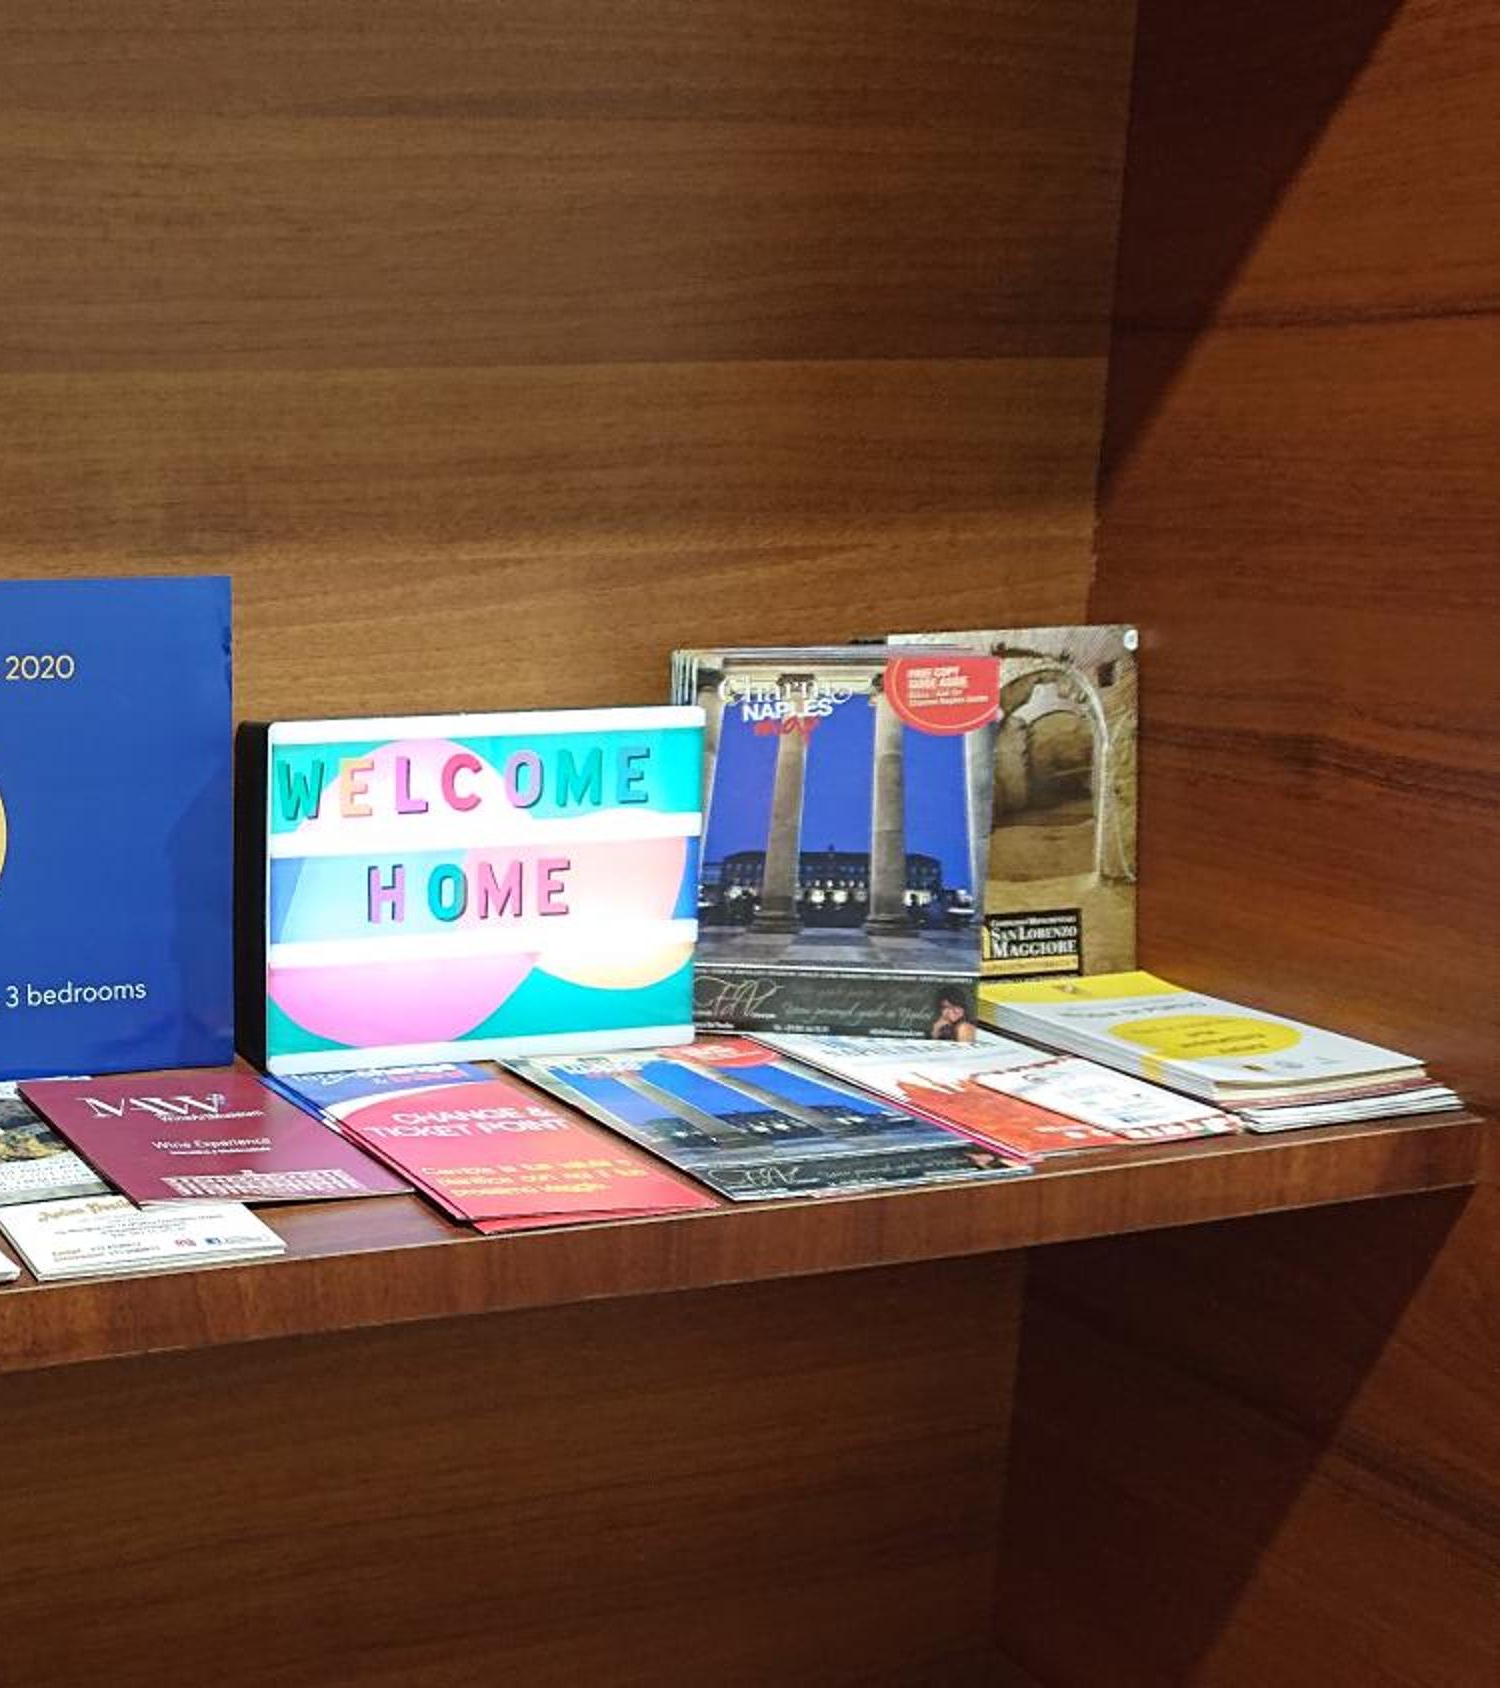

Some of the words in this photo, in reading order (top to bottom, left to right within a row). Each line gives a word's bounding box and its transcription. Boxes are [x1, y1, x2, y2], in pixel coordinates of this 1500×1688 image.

[5, 654, 76, 681] 2020
[742, 697, 834, 722] NAPLES
[276, 746, 652, 822] WELCOME
[367, 857, 572, 924] HOME
[1019, 925, 1077, 941] LORENZO
[992, 939, 1077, 958] MAGGIORE
[5, 987, 20, 1009] 3
[27, 979, 148, 1008] bedrooms
[392, 1107, 525, 1125] CHANGE
[528, 1106, 558, 1118] &
[363, 1123, 472, 1138] TICKET
[476, 1119, 571, 1135] POINT
